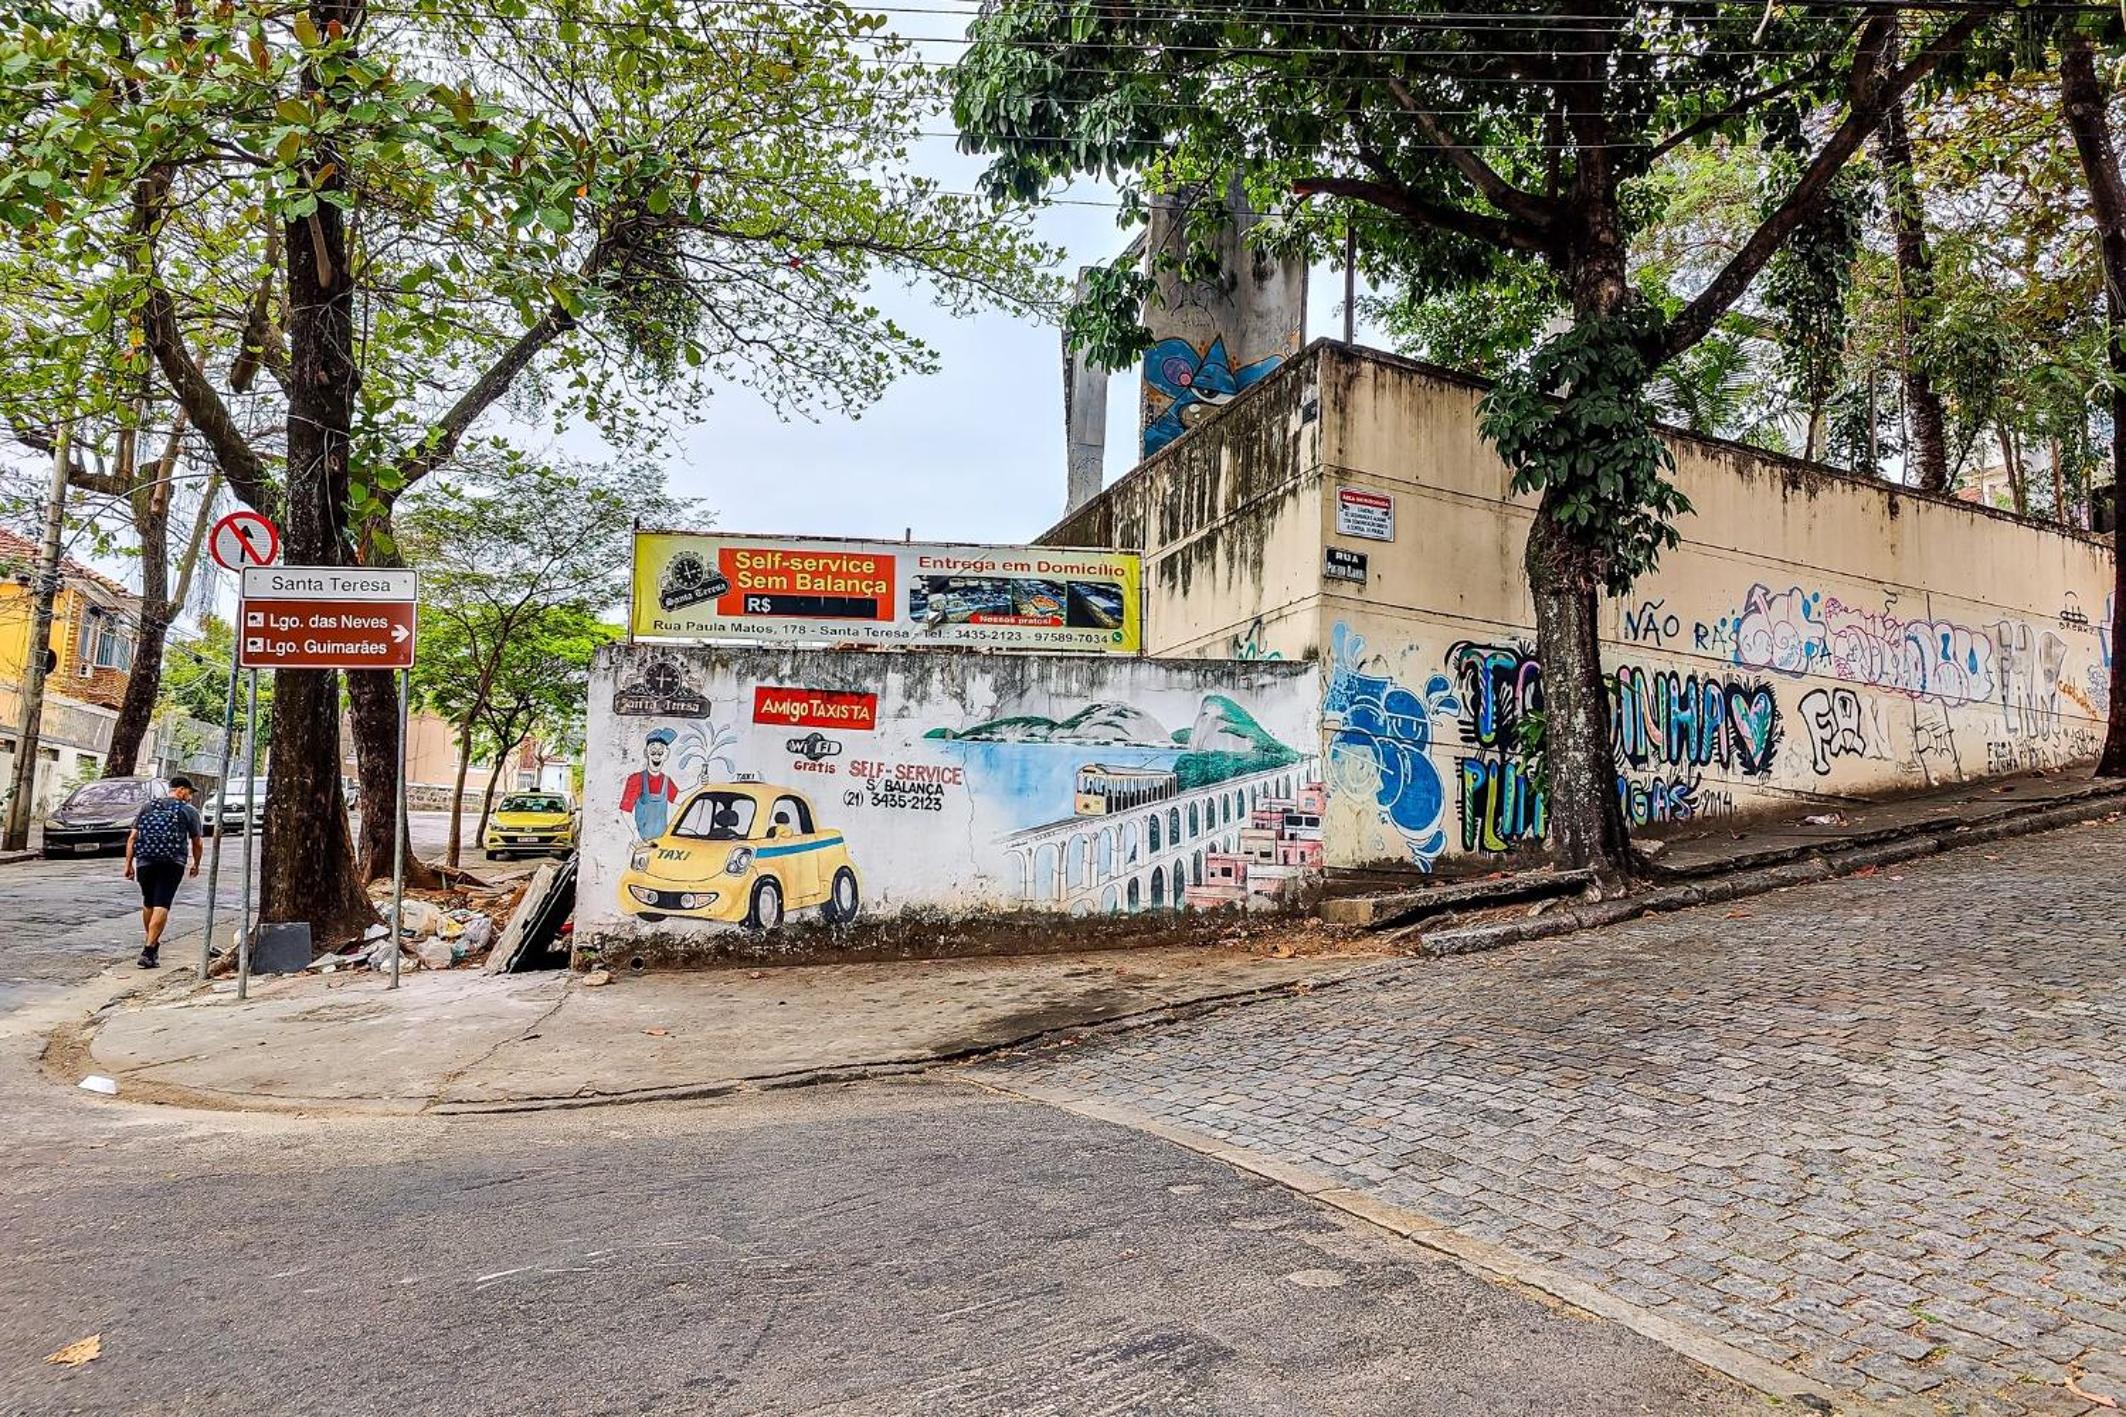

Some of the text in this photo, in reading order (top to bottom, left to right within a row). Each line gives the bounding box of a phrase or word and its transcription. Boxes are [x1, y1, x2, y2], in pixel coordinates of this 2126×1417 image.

[735, 551, 876, 574] Self-service
[918, 556, 1125, 577] Entrega em Domicílio
[1335, 551, 1359, 564] RUA
[272, 576, 391, 592] Santa Teresa
[737, 571, 887, 598] Sem Balança
[747, 598, 772, 613] R$
[269, 614, 388, 631] Lgo. das Neves
[653, 620, 681, 631] Rua
[686, 621, 726, 632] Paula
[731, 622, 778, 635] Matos,
[782, 624, 807, 635] 178
[820, 626, 860, 637] Santa
[864, 627, 910, 638] Teresa
[955, 629, 1022, 641] 3435-2123
[1034, 632, 1108, 644] 97589-7034
[1624, 599, 1680, 646] NÃO
[266, 640, 387, 656] Lgo. Guimarães
[849, 759, 963, 786] SELF-SERVICE
[884, 778, 945, 797] BALANÇA
[842, 790, 943, 812] (21) 3435-2123
[656, 848, 692, 861] TAXI
